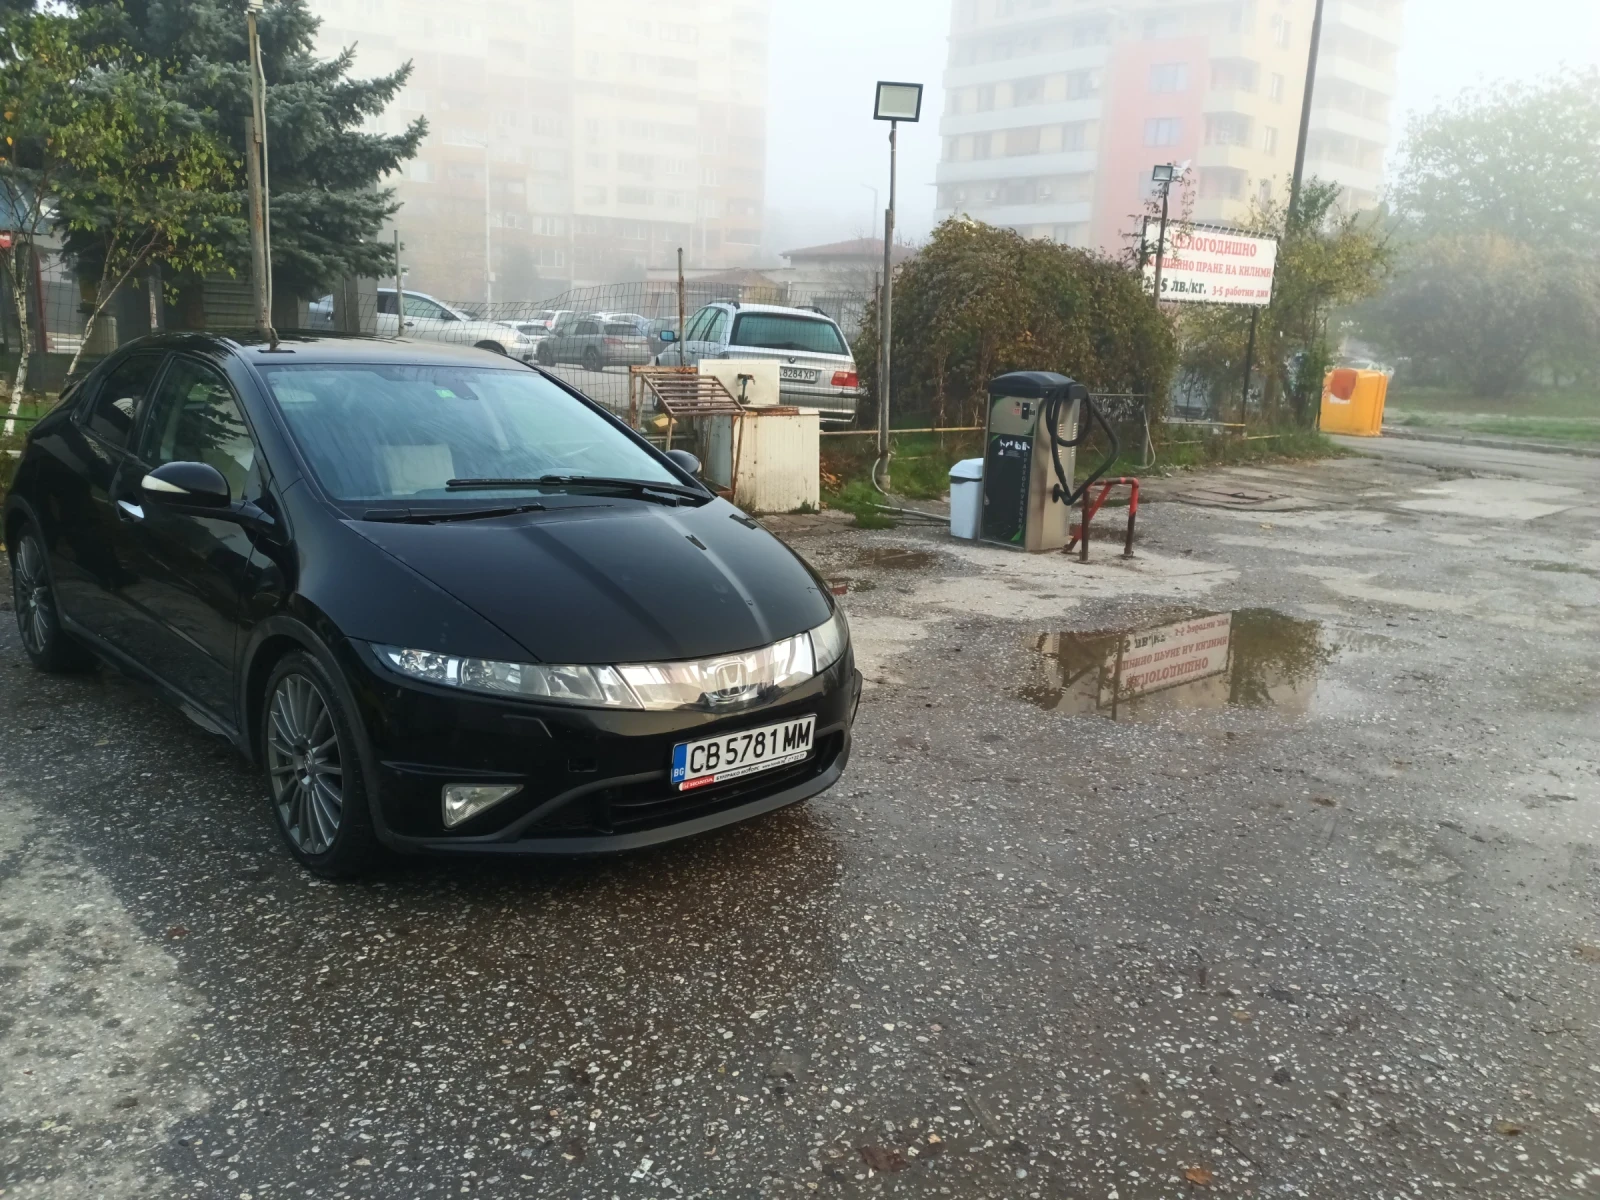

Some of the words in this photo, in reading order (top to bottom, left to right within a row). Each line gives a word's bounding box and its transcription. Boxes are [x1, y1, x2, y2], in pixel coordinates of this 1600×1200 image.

[1196, 261, 1224, 274] ПРАНЕ
[1225, 264, 1237, 275] НА
[1239, 266, 1271, 278] КИЛИМИ
[1212, 285, 1223, 296] 3-5
[1225, 286, 1254, 298] работни
[1255, 289, 1269, 298] дни
[725, 728, 777, 765] 5781
[674, 767, 685, 778] BG
[690, 778, 713, 787] HONDA
